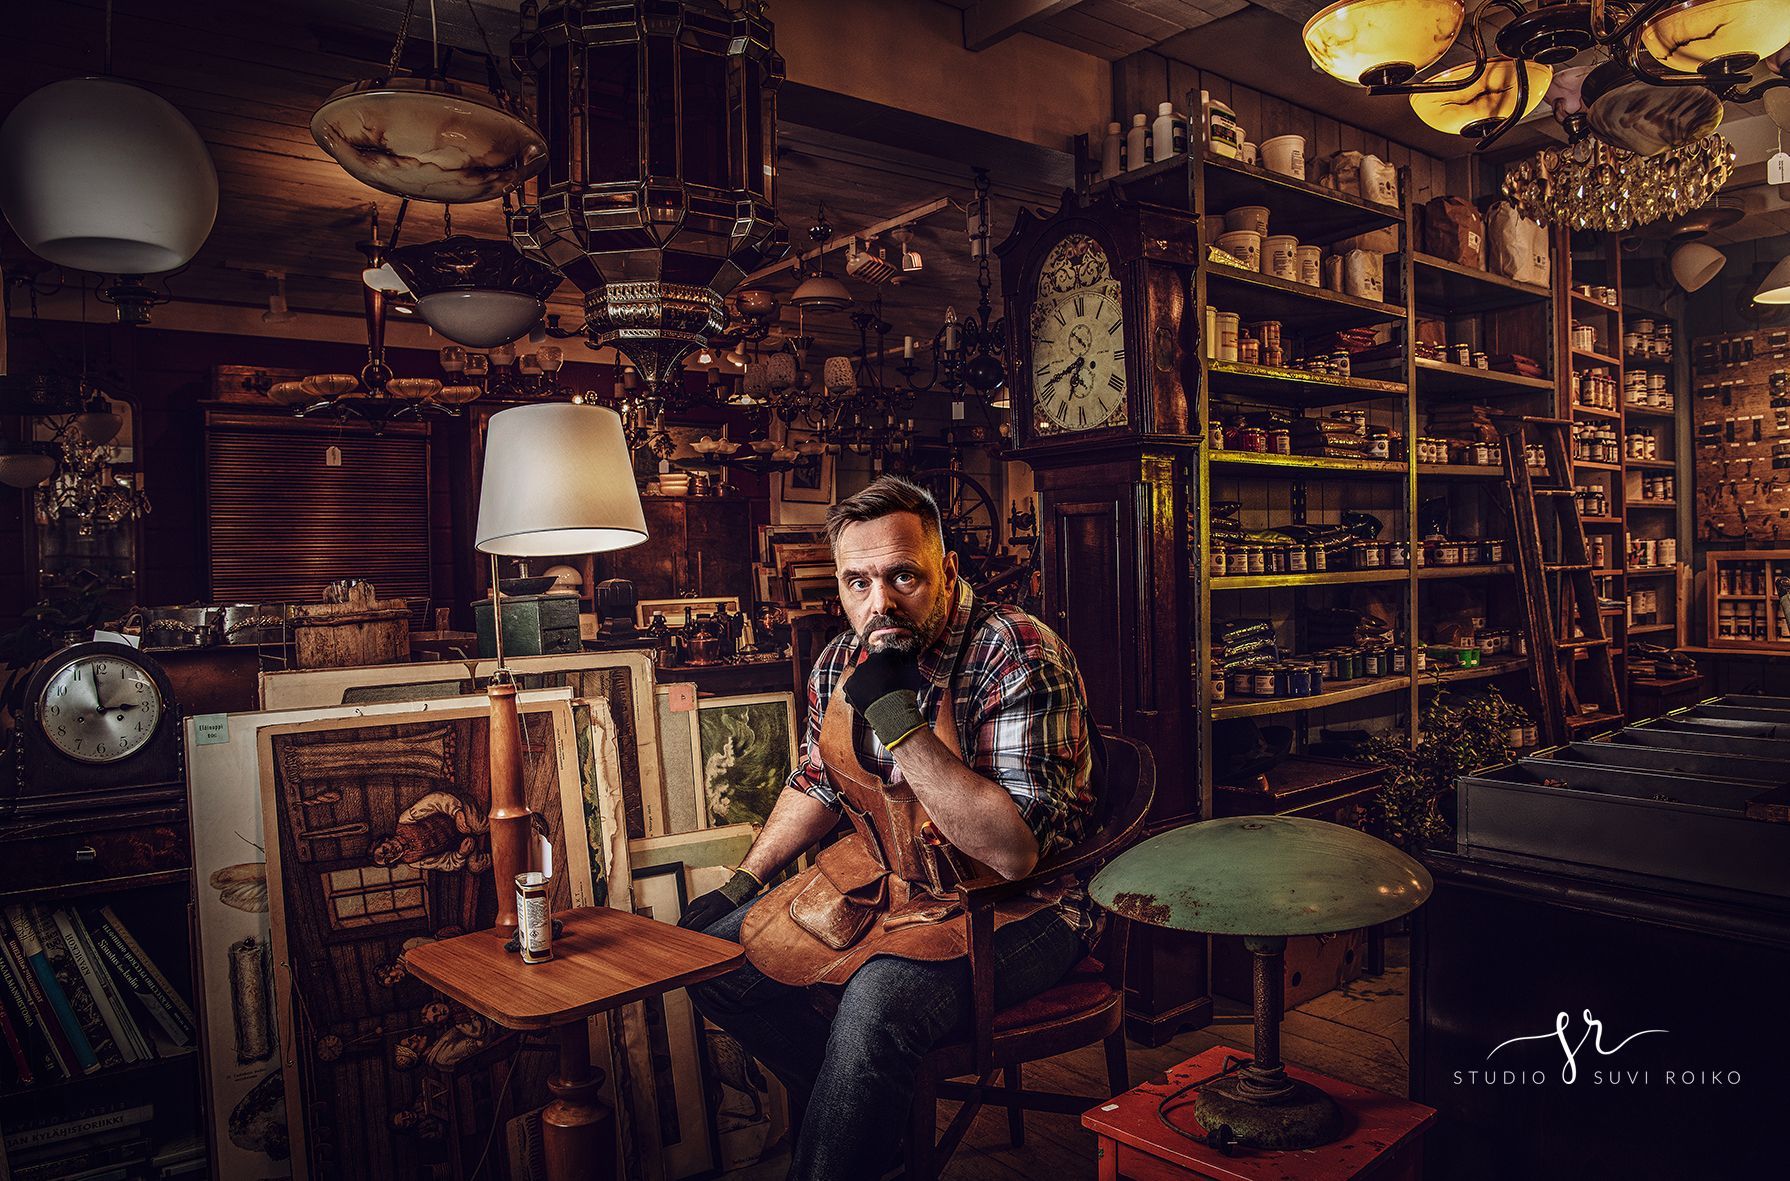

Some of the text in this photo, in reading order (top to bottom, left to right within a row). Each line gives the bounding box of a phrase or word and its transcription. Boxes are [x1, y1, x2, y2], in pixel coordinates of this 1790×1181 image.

[96, 663, 107, 675] 12
[73, 670, 81, 681] 11
[57, 685, 67, 696] 10
[135, 682, 143, 693] 2
[51, 706, 60, 716] 9
[141, 701, 150, 713] 3
[57, 724, 66, 736] 8
[134, 721, 143, 732] 4
[74, 738, 83, 750] 7
[119, 736, 128, 747] 5
[97, 743, 106, 754] 6
